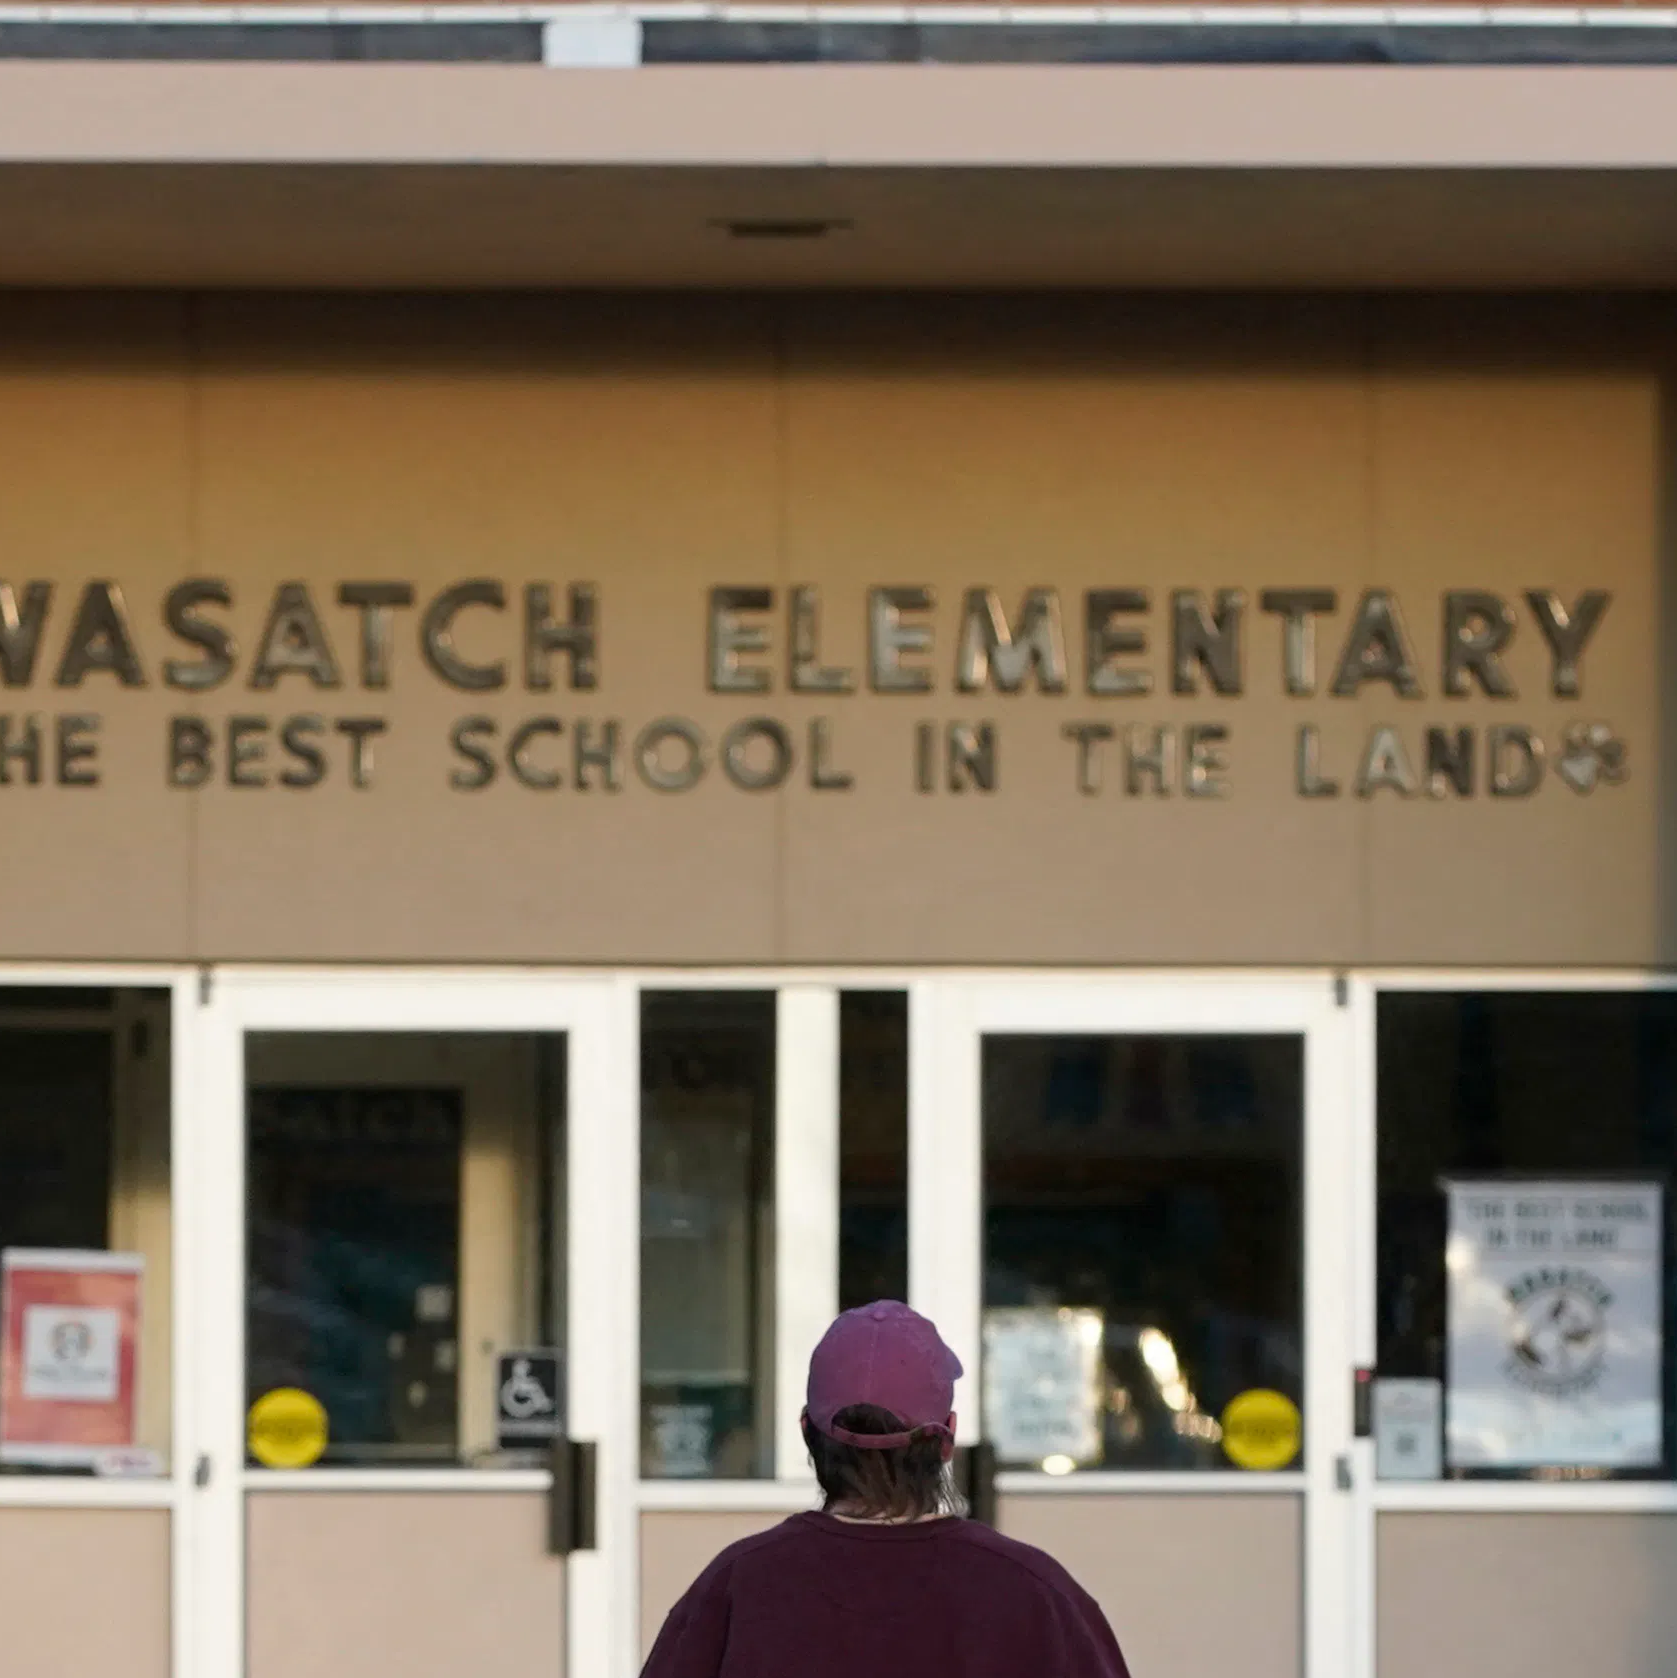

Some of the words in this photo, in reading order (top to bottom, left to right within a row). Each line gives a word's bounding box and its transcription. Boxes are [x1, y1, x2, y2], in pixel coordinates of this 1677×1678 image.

[707, 582, 1616, 699] ELEMENTARY
[167, 714, 390, 791] BEST
[447, 714, 855, 795] SCHOOL
[912, 716, 999, 795] IN
[1060, 720, 1230, 800] THE
[1294, 721, 1546, 802] LAND
